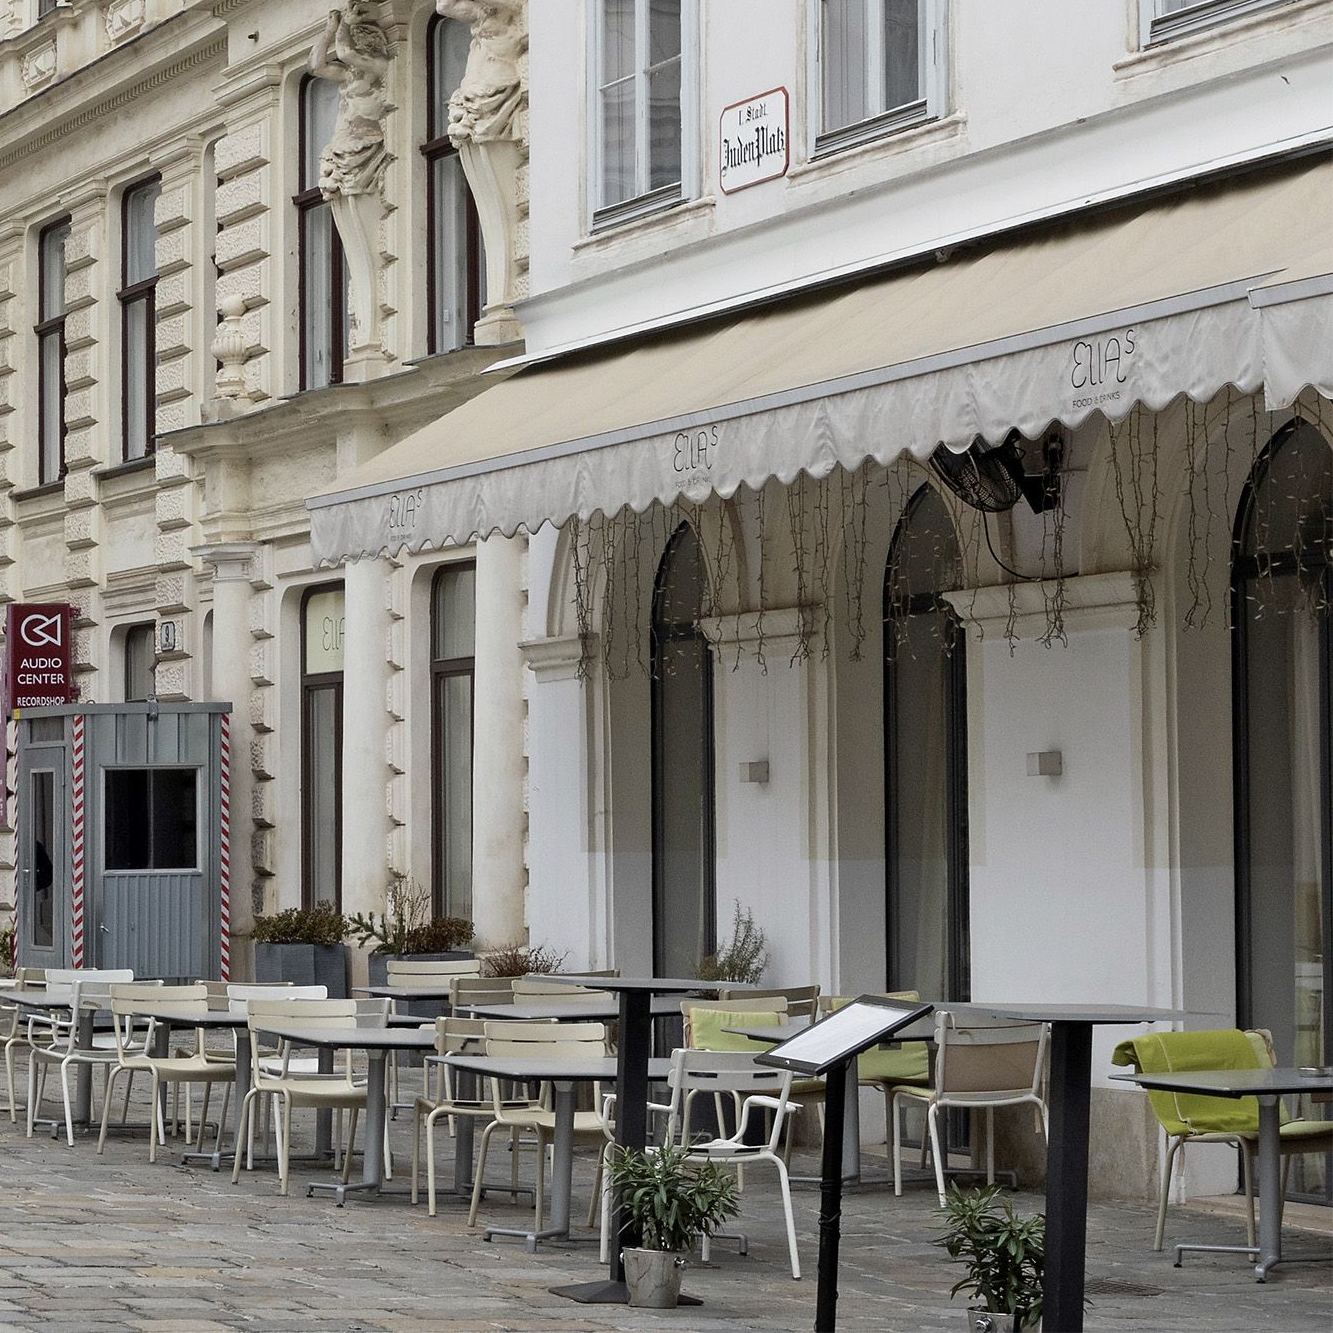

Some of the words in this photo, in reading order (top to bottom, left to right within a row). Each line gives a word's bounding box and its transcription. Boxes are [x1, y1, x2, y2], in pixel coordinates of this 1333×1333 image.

[165, 625, 170, 643] 9
[20, 657, 63, 669] AUDIO
[17, 673, 65, 685] CENTER
[17, 696, 66, 707] RECORDSHOP
